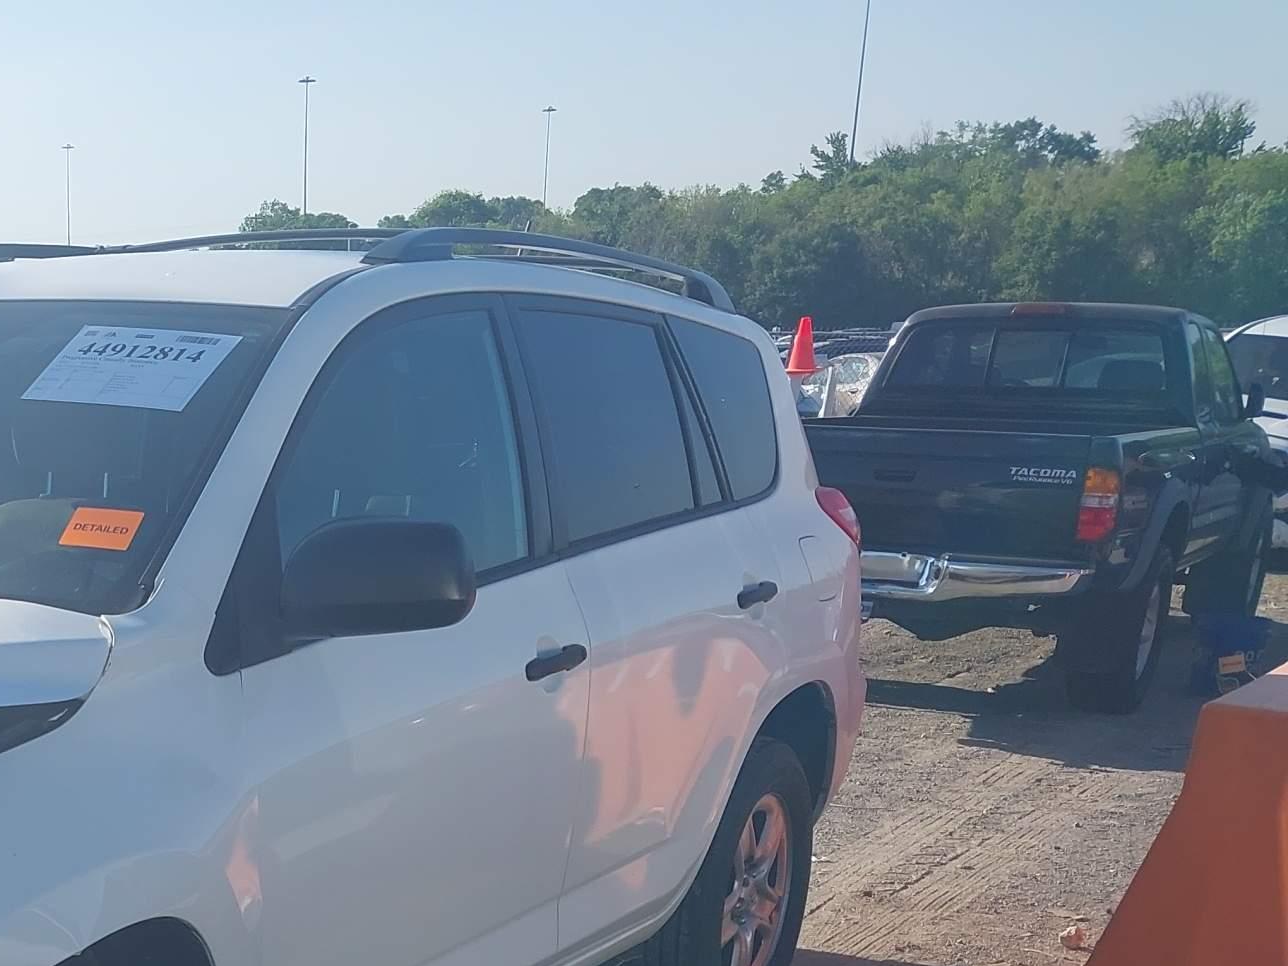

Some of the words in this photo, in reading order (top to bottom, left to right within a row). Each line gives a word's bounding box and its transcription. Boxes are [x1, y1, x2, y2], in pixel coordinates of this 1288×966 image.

[78, 341, 206, 363] 44912814
[1009, 466, 1077, 479] TACOMA
[73, 522, 129, 535] DETAILED
